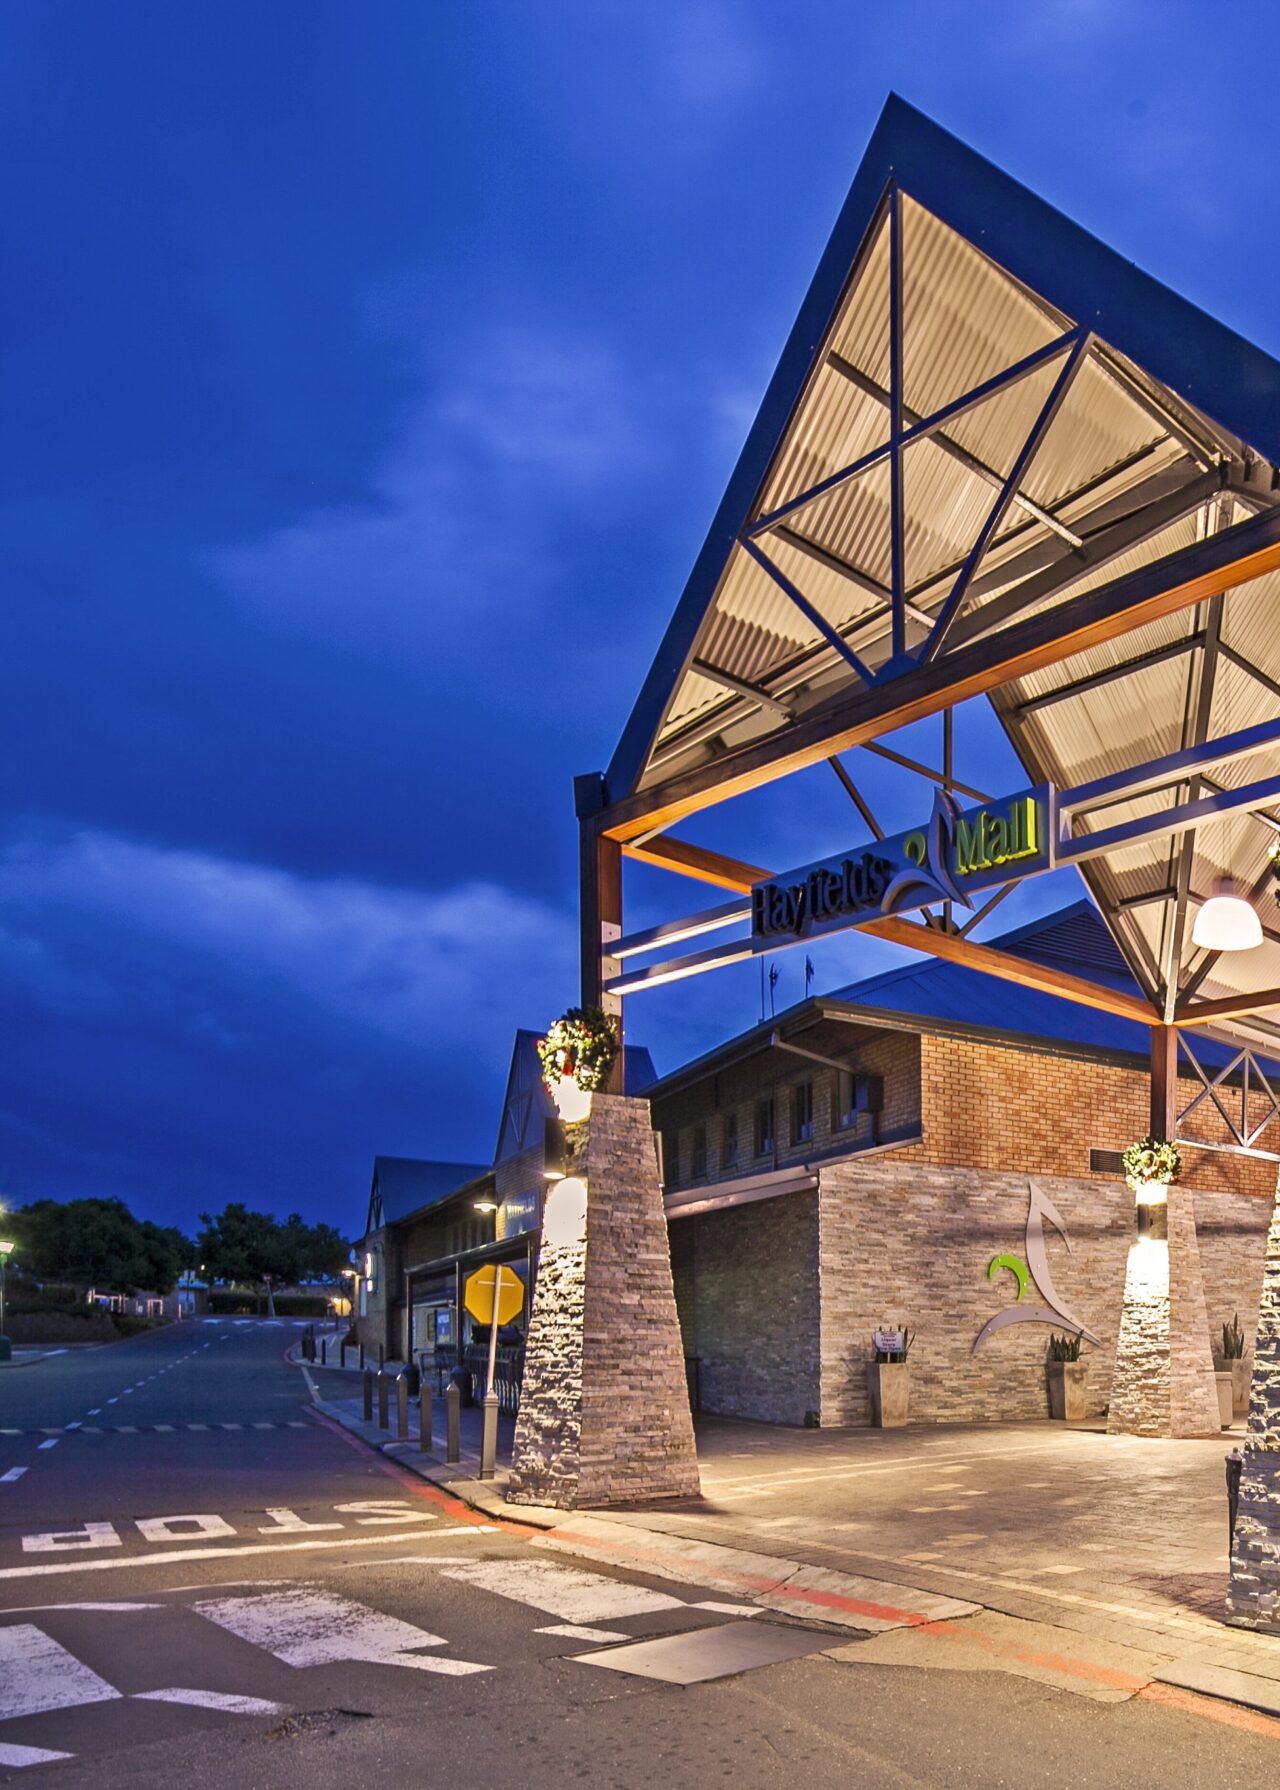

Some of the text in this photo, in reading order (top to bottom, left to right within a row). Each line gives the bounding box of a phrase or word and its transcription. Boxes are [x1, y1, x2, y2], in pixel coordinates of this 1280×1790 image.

[752, 797, 1038, 935] Hayfields Mall
[22, 1501, 438, 1552] STOP
